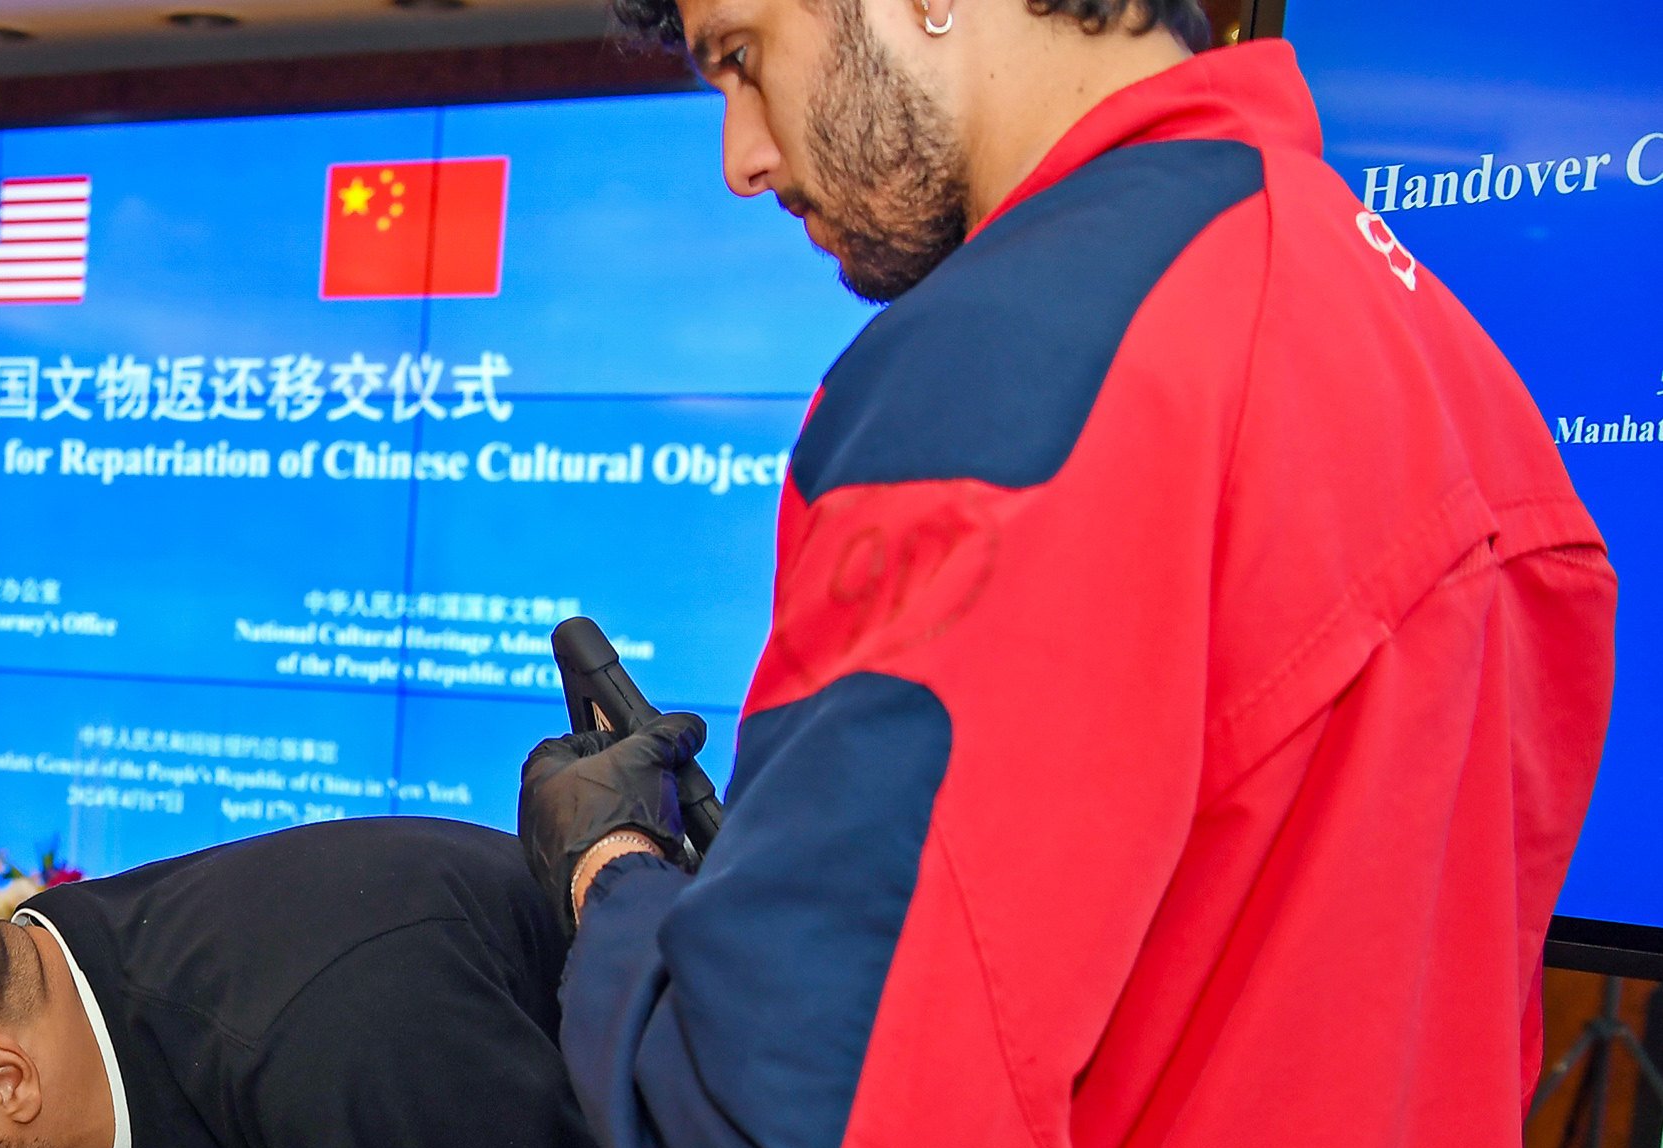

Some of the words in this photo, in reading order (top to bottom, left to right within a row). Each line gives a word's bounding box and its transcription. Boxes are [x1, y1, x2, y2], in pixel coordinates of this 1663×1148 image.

[1362, 153, 1611, 212] Handover
[4, 438, 53, 475] for
[60, 439, 269, 485] Repatriation
[278, 440, 320, 480] of
[323, 440, 468, 482] Chinese
[476, 441, 644, 485] Cultural
[652, 442, 790, 495] Object
[235, 619, 318, 644] National
[320, 622, 403, 647] Cultural
[277, 652, 300, 674] of
[302, 653, 332, 675] the
[335, 654, 415, 683] Peoples
[418, 659, 507, 687] Republic
[511, 663, 536, 686] of
